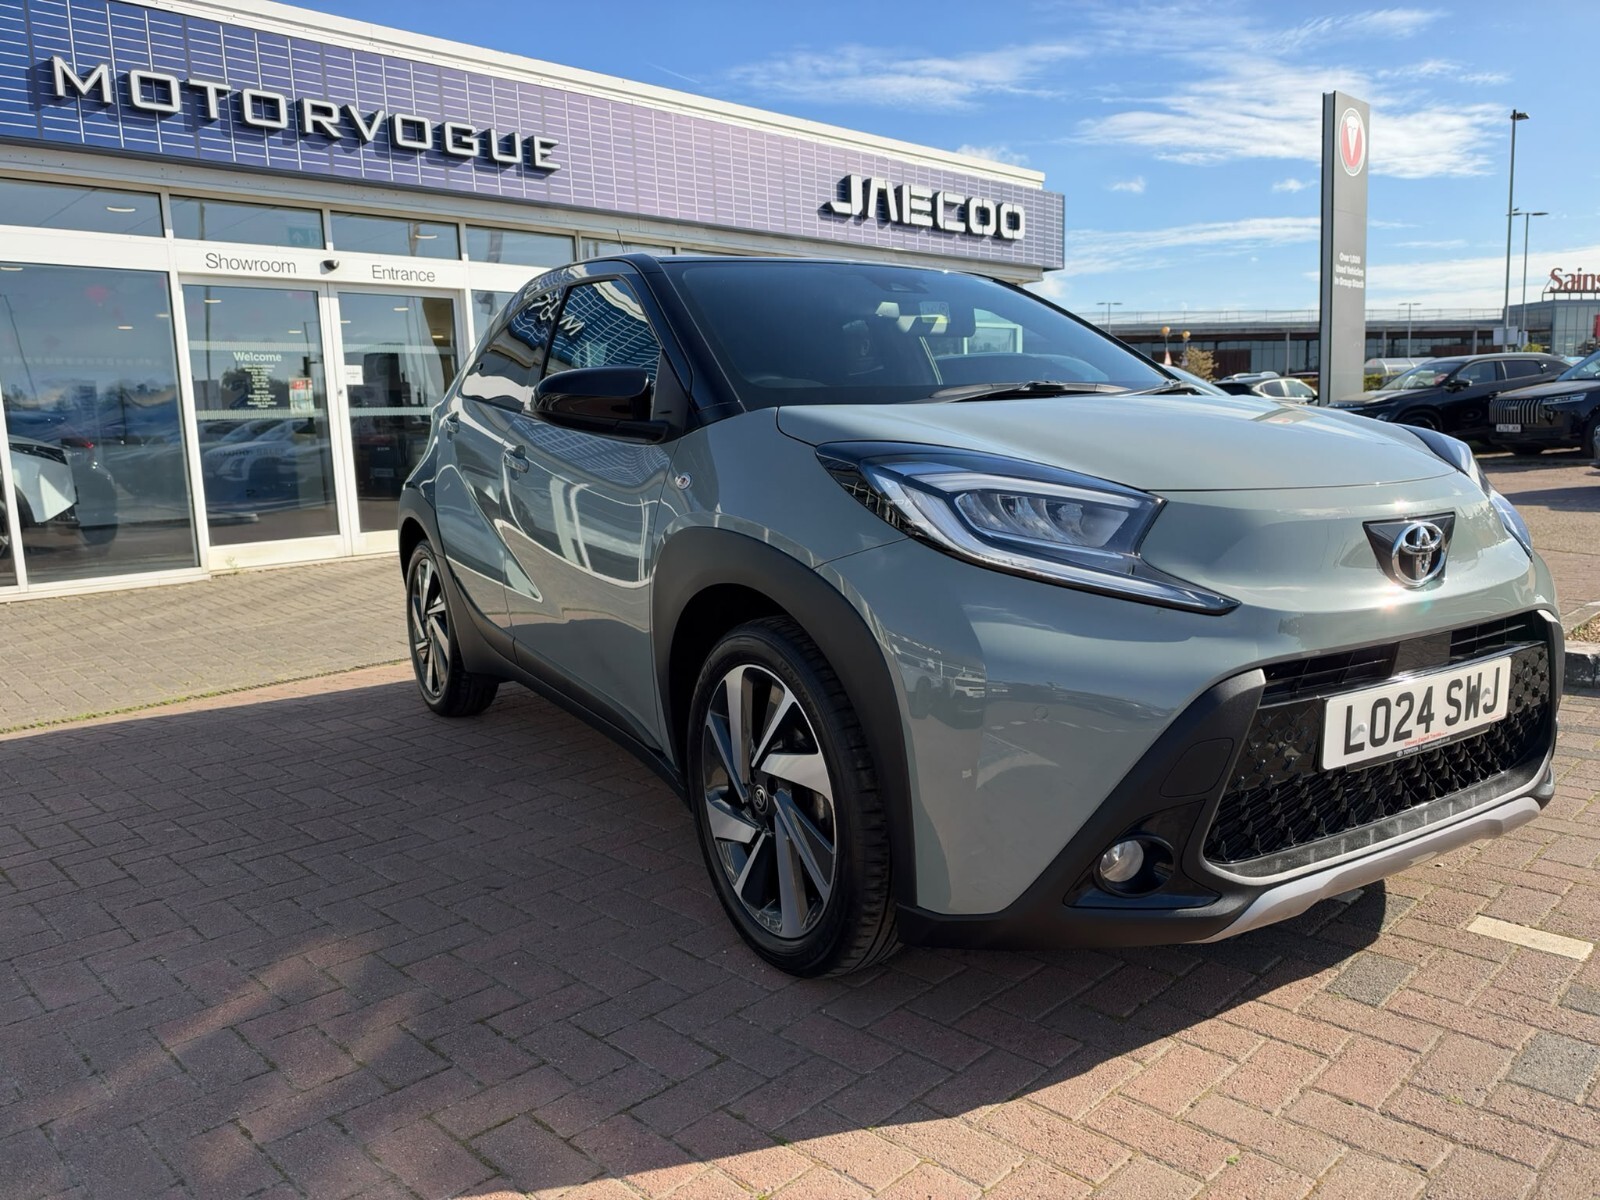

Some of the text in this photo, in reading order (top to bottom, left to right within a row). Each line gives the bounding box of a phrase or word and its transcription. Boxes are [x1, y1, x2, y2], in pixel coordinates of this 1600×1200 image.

[50, 55, 561, 172] MOTORVOGUE
[829, 174, 1026, 240] JAECOO
[205, 252, 297, 274] Showroom
[371, 264, 436, 283] Entrance
[233, 351, 282, 362] Welcome
[1444, 667, 1501, 727] SWJ
